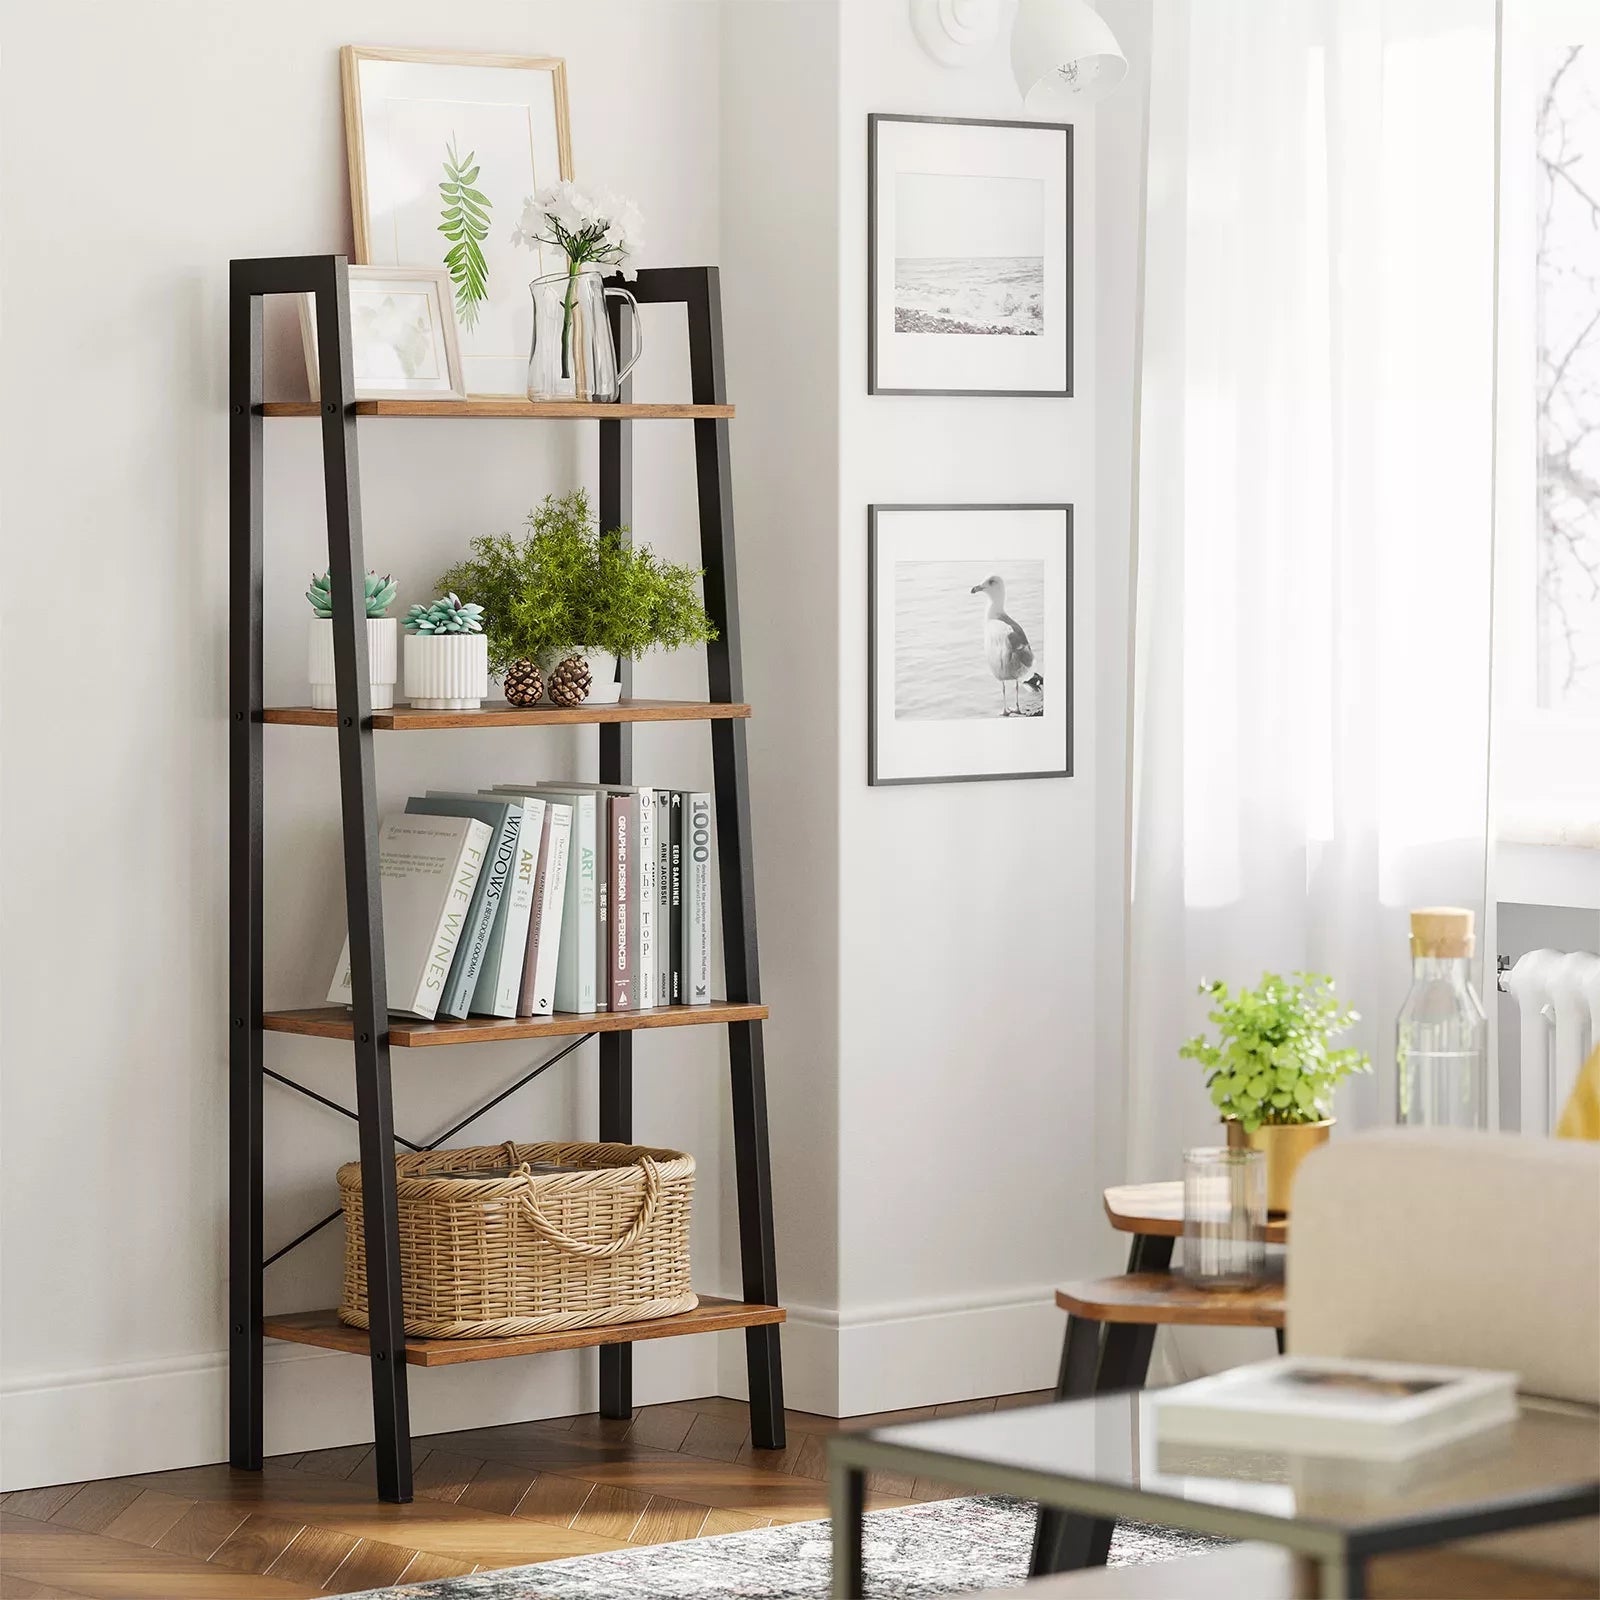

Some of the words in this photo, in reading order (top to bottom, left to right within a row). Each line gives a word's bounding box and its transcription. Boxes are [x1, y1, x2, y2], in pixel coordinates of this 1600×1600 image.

[618, 815, 627, 861] GRAPHIC
[641, 795, 650, 846] Over
[693, 801, 709, 863] 1000
[453, 847, 481, 904] FINE
[486, 815, 522, 900] WINDOWS
[518, 848, 533, 885] ART
[581, 847, 594, 881] ART
[618, 863, 627, 901] DESIGN
[477, 906, 493, 943] BERGDORF
[618, 903, 627, 970] REFERENCED
[642, 912, 650, 956] Top
[426, 913, 462, 991] WINES
